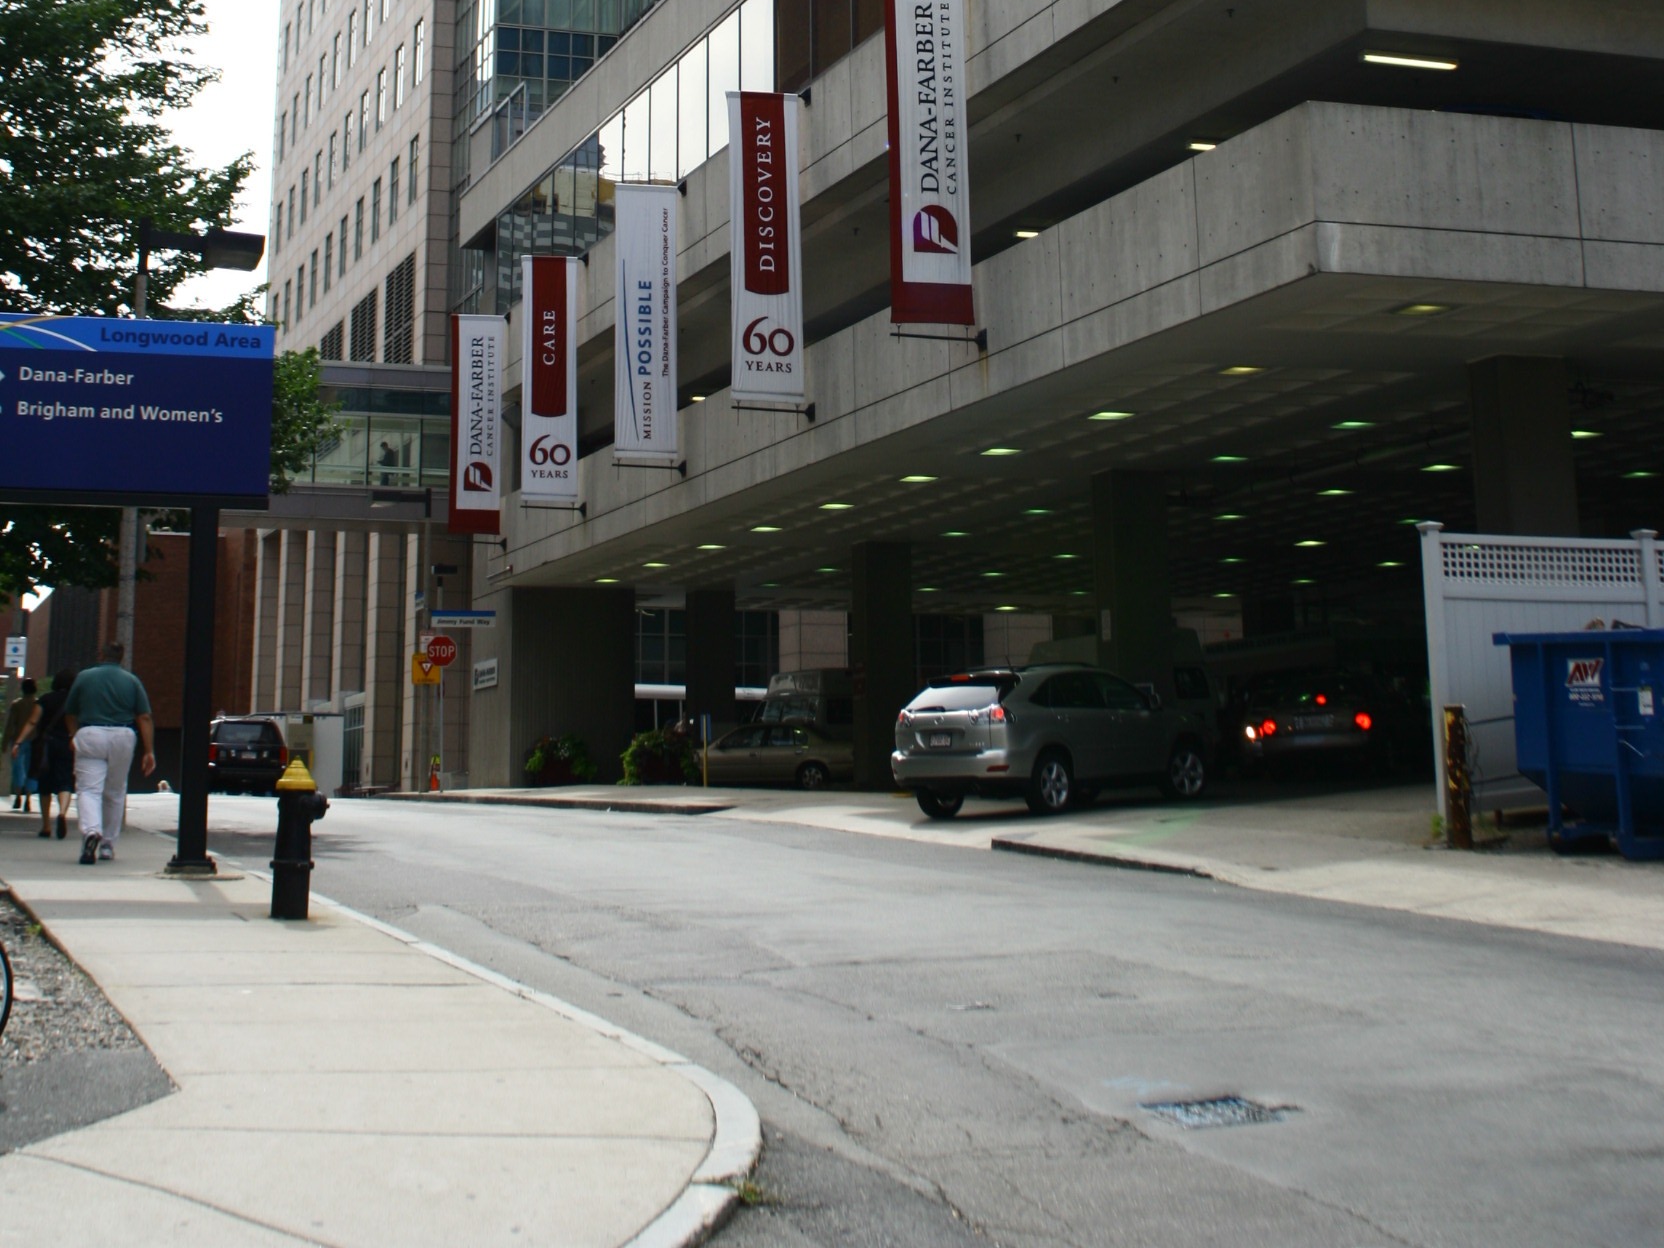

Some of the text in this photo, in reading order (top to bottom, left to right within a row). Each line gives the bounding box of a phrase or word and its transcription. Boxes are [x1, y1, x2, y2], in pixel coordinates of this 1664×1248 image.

[914, 2, 940, 195] DANA-FARBER
[940, 2, 957, 195] CANCER INSTITUTE
[756, 116, 775, 273] DISCOVERY
[662, 235, 671, 265] Conquer
[662, 267, 669, 275] to
[662, 278, 670, 315] Campaign
[101, 327, 262, 349] Longwood Area
[542, 309, 556, 366] CARE
[661, 316, 669, 362] Dana-Farber
[742, 316, 795, 357] 60
[19, 366, 135, 386] Dana-Farber
[638, 279, 652, 440] MISSION POSSIBLE
[661, 363, 669, 377] The
[745, 360, 792, 374] YEARS
[17, 401, 223, 424] Brigham and Women's
[469, 335, 485, 456] DANA-FARBER
[487, 336, 496, 456] CANCER INSTITUTE
[529, 434, 571, 467] 60
[531, 469, 569, 479] YEARS
[428, 645, 454, 657] STOP
